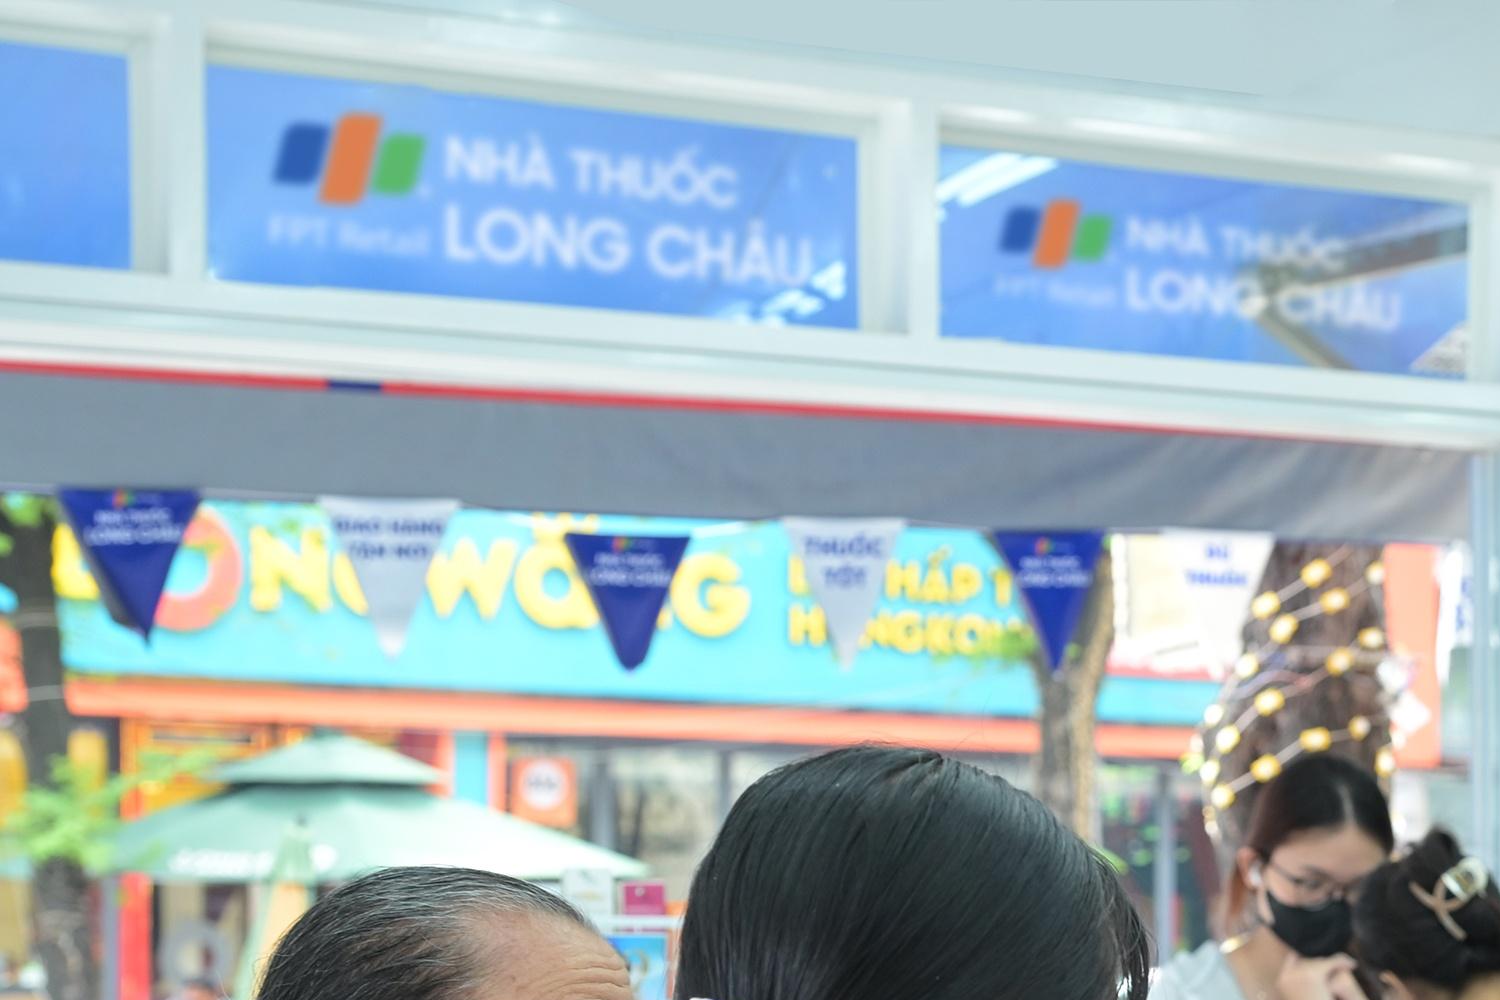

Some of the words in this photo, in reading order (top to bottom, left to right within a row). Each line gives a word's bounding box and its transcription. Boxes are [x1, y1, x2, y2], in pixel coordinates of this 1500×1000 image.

[445, 135, 555, 191] NHÀ
[568, 147, 738, 209] THUỐC
[444, 206, 631, 273] LONG
[646, 219, 815, 286] CHÂU
[1126, 210, 1209, 257] NHÀ
[1125, 265, 1269, 320] LONG
[1277, 280, 1401, 330] CHÂU
